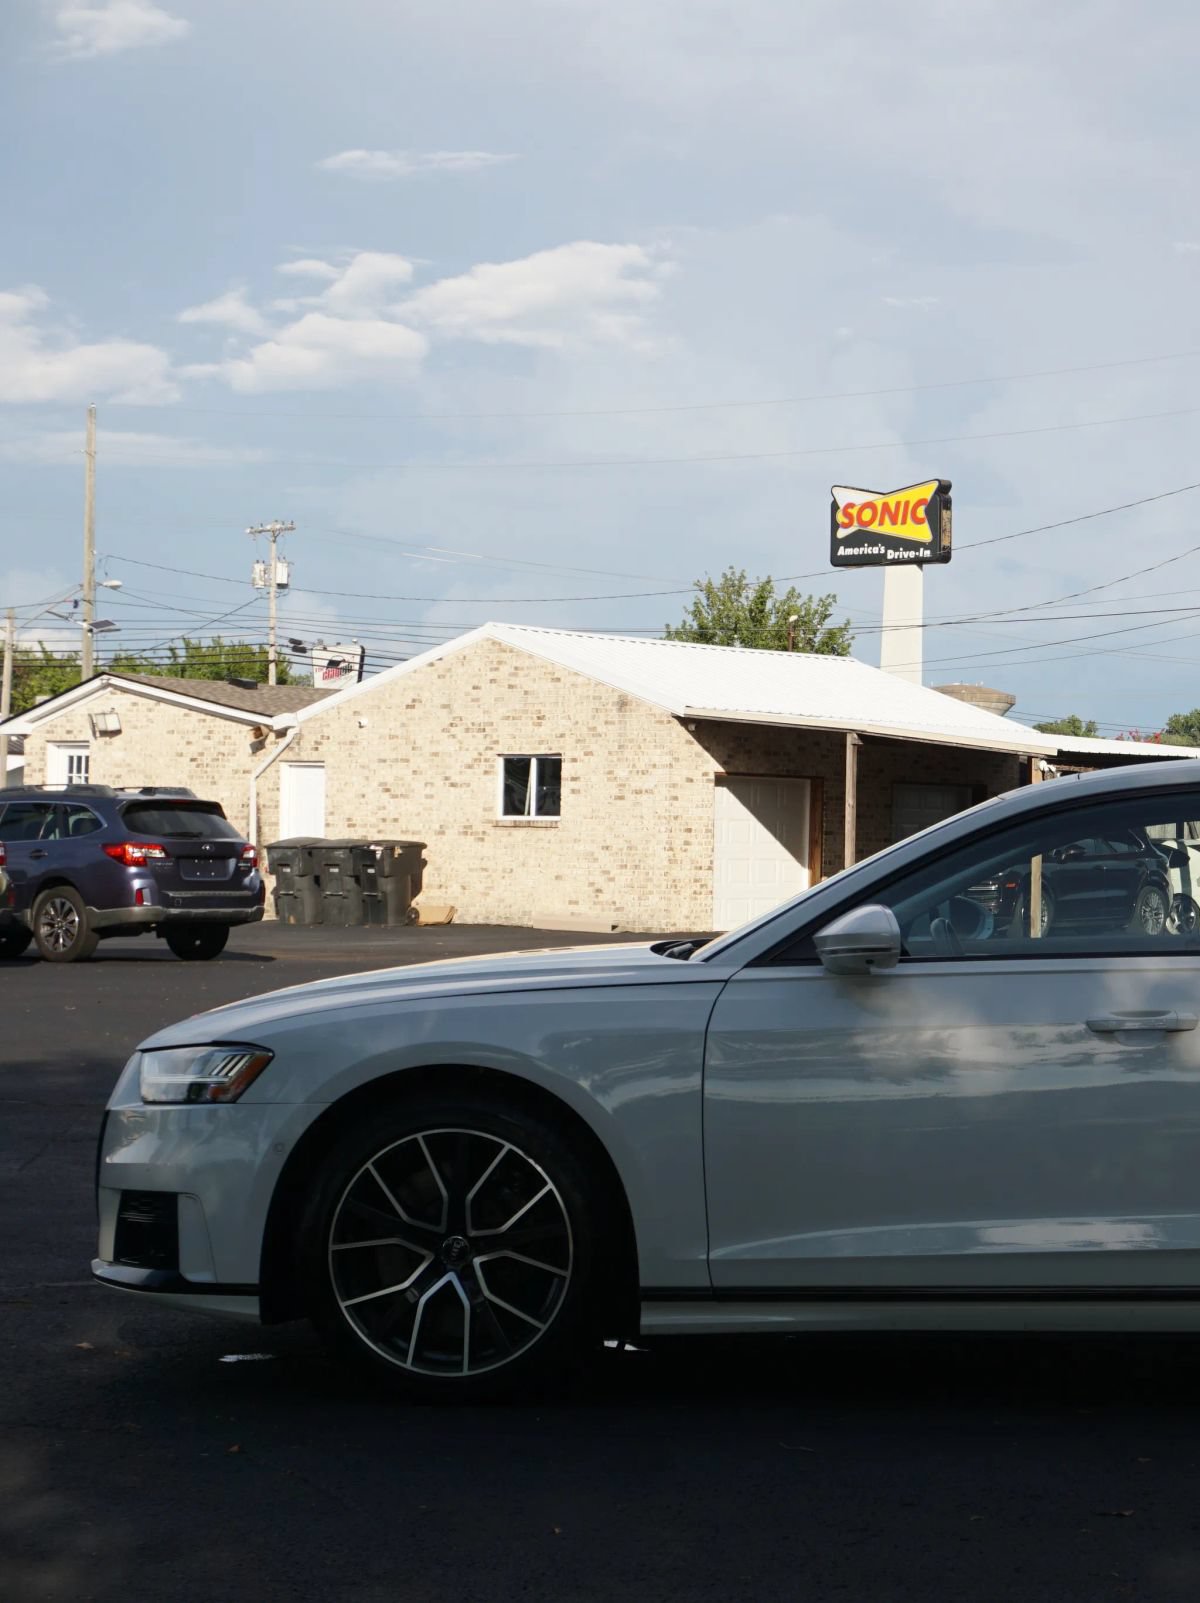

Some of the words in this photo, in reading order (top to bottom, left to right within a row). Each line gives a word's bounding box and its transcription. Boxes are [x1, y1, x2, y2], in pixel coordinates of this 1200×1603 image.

[839, 498, 929, 529] SONIC
[837, 543, 886, 556] America's
[886, 547, 931, 560] Drive-In
